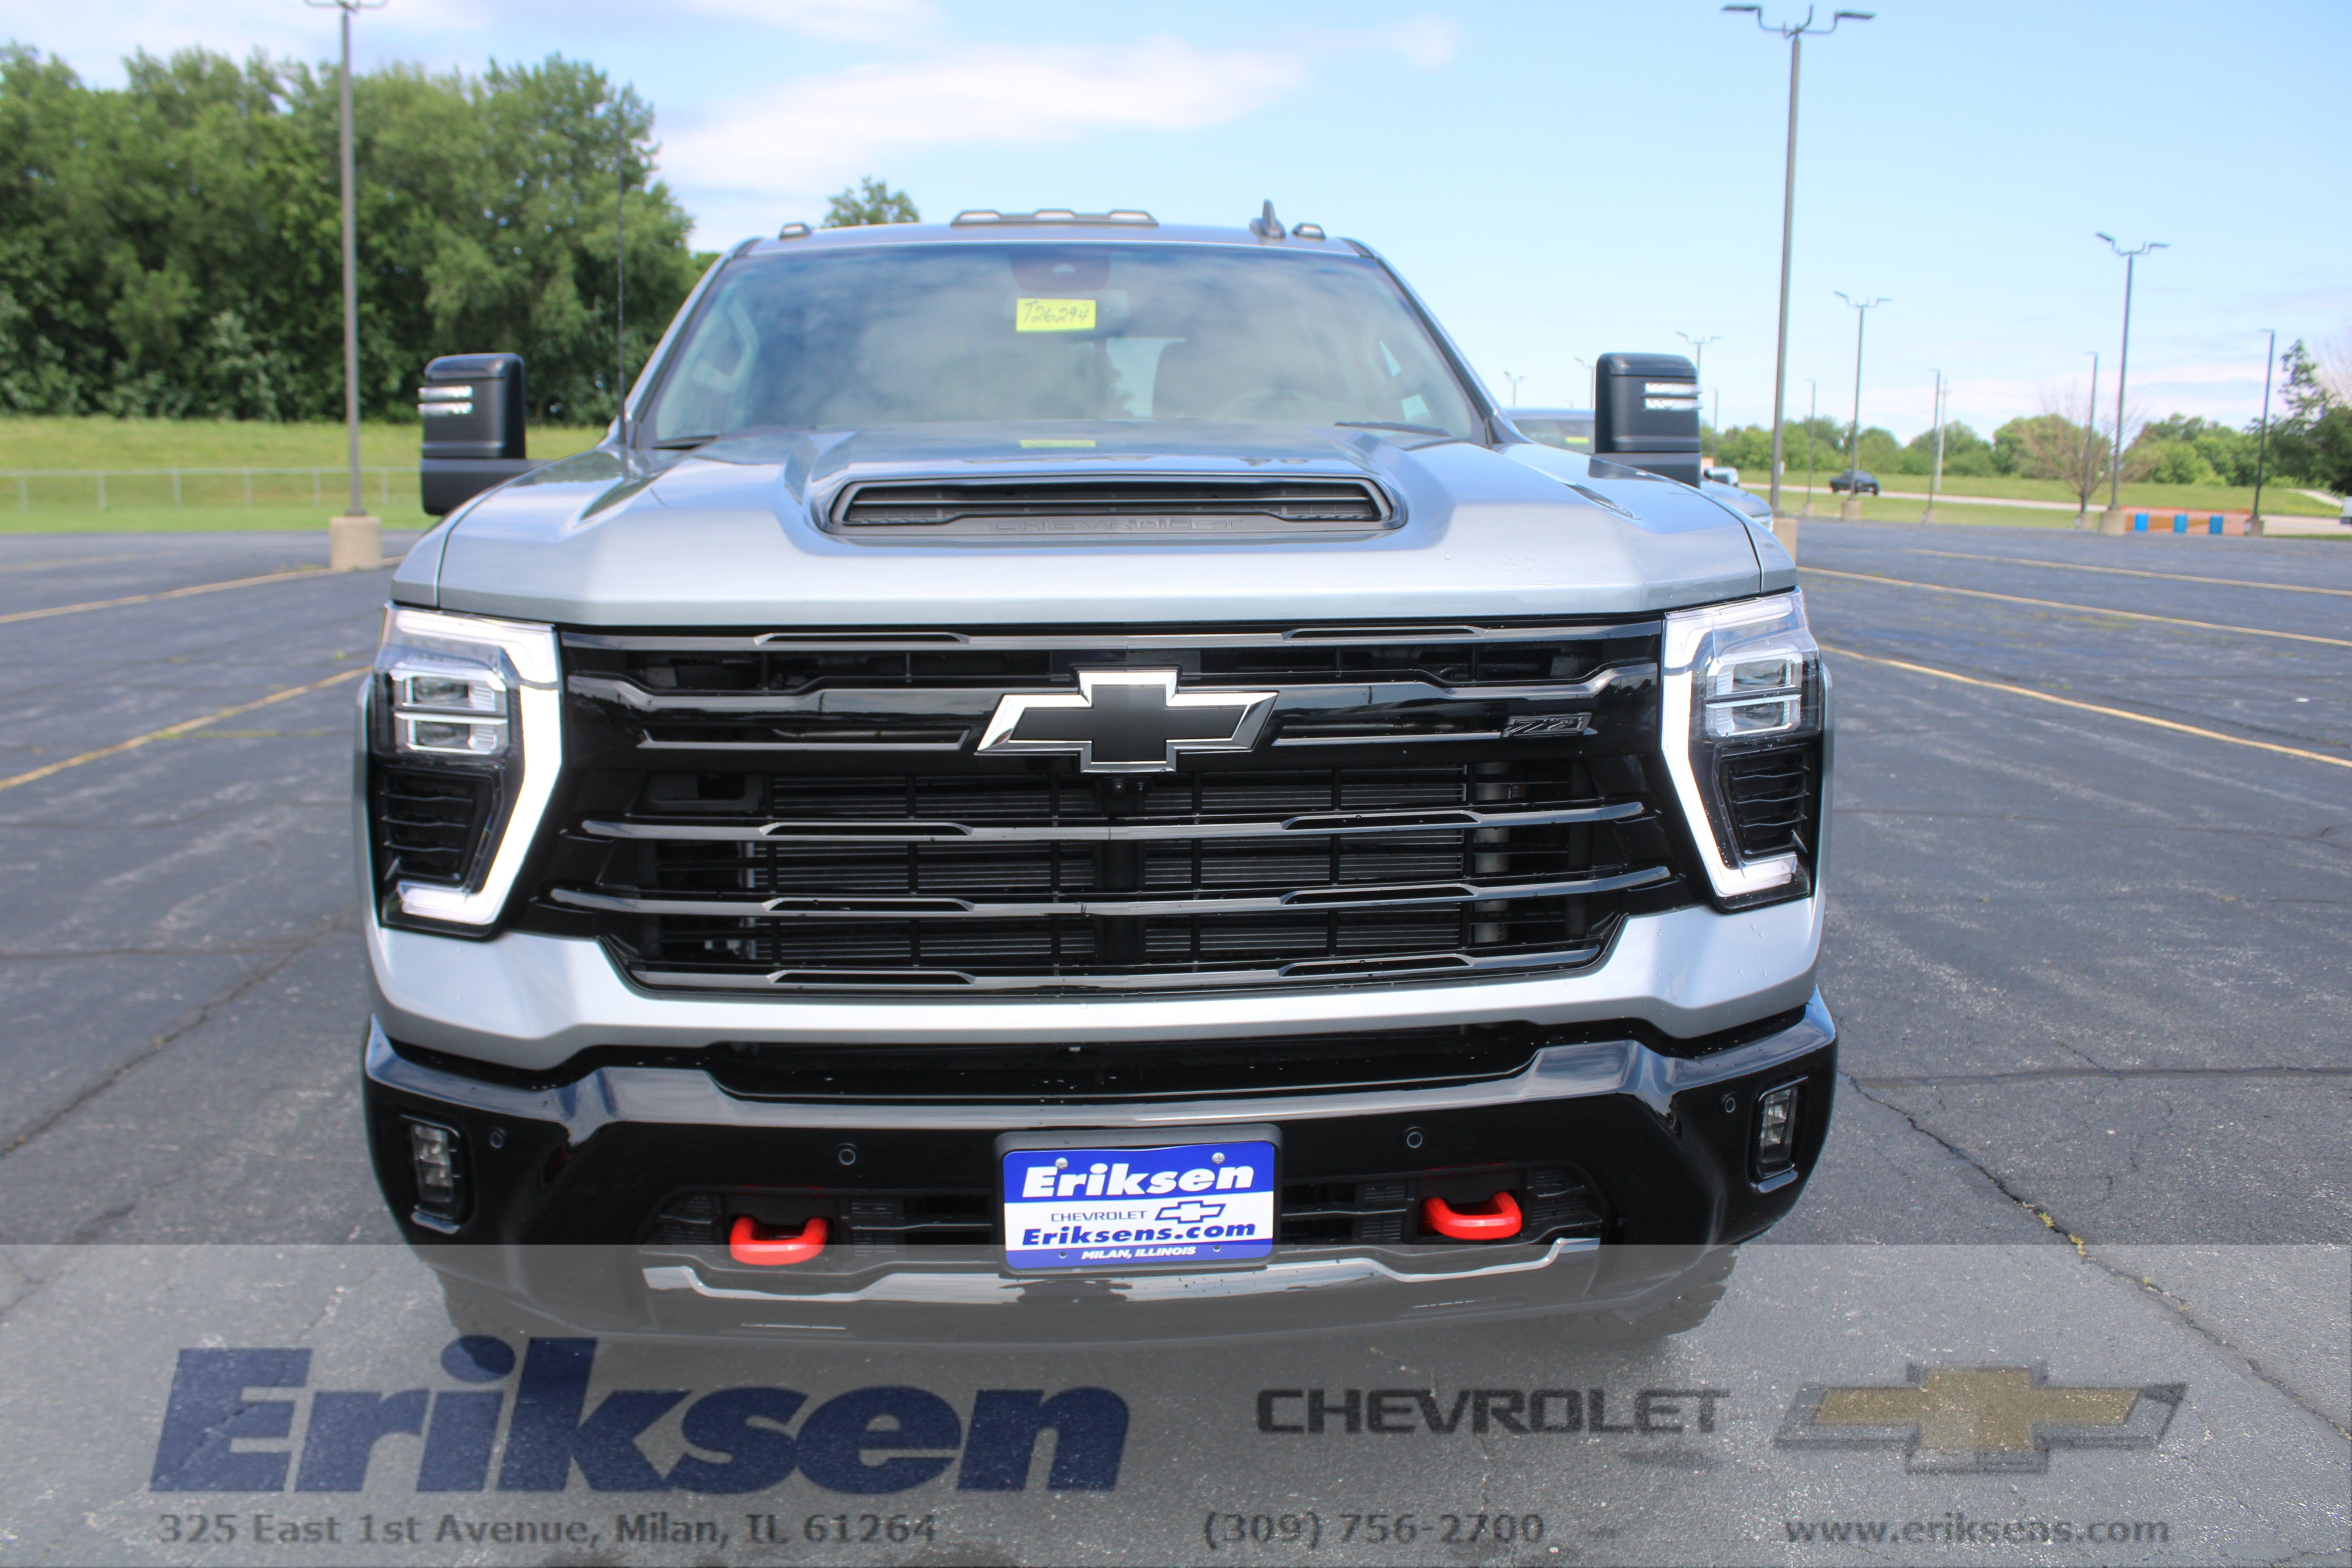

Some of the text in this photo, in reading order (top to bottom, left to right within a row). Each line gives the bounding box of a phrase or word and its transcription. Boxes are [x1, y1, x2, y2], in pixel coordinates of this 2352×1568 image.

[990, 517, 1242, 531] CHEVROLET
[1022, 1163, 1255, 1198] Eriksen
[1051, 1210, 1148, 1222] CHEVROLET
[1022, 1223, 1256, 1246] Eriksens.com
[1081, 1247, 1197, 1260] MILAN, ILLINOIS
